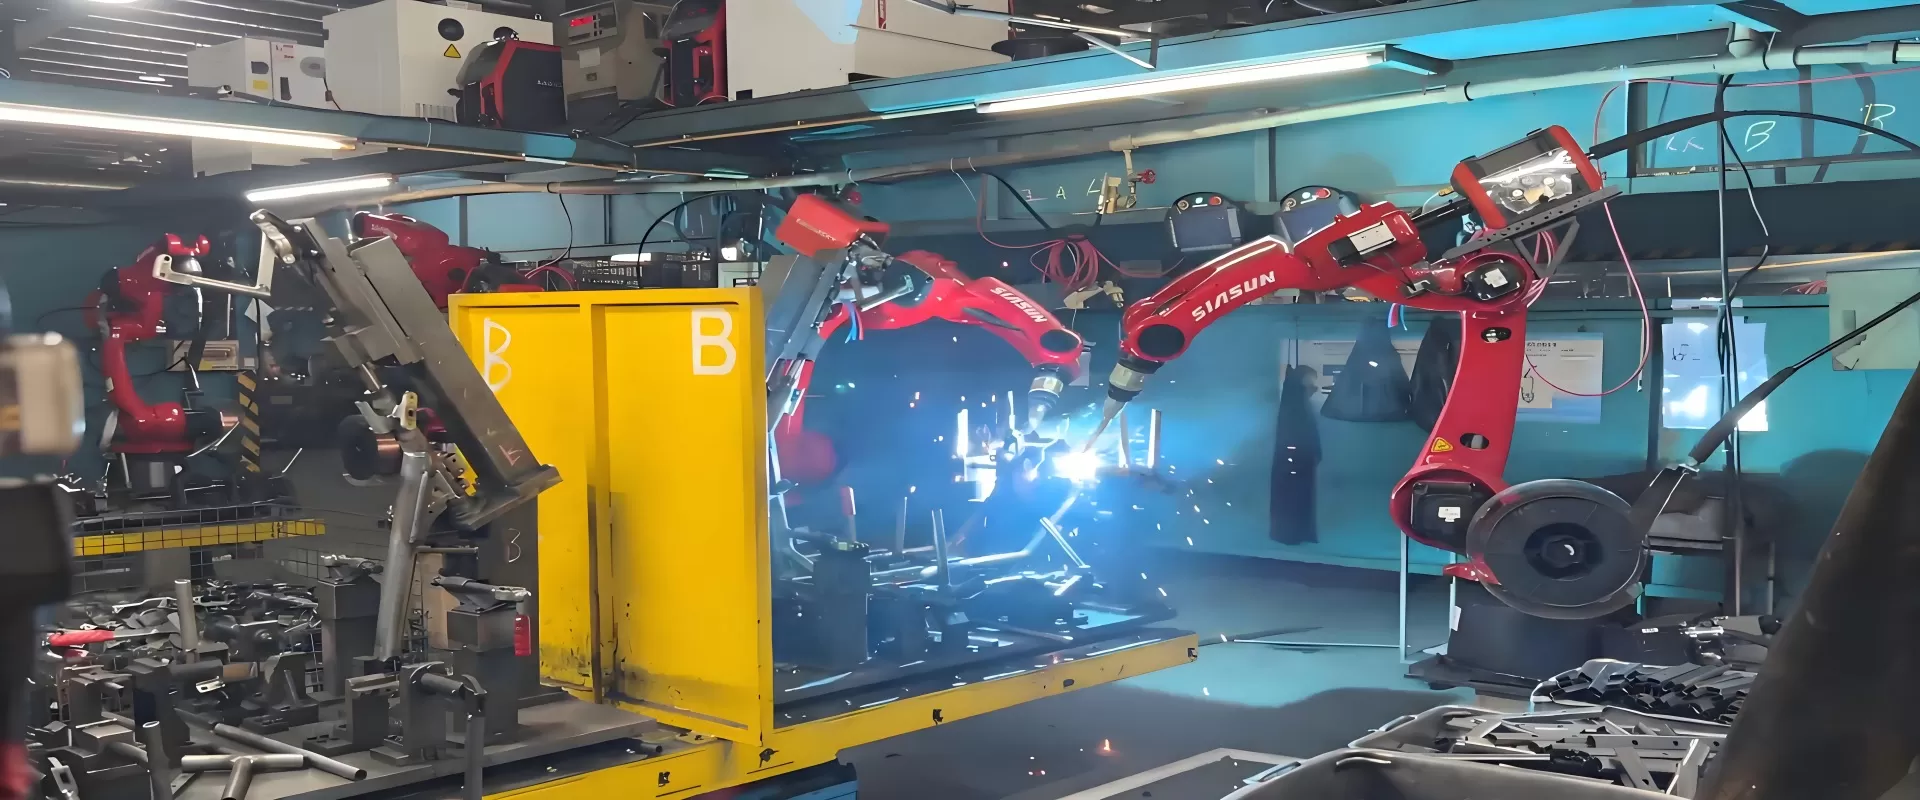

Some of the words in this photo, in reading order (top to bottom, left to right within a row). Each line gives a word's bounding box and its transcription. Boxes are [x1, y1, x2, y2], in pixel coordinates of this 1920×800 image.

[1745, 120, 1777, 152] B
[990, 286, 1048, 323] SIASUN
[1192, 270, 1275, 322] SIASUN
[483, 317, 512, 394] B
[691, 306, 738, 376] B
